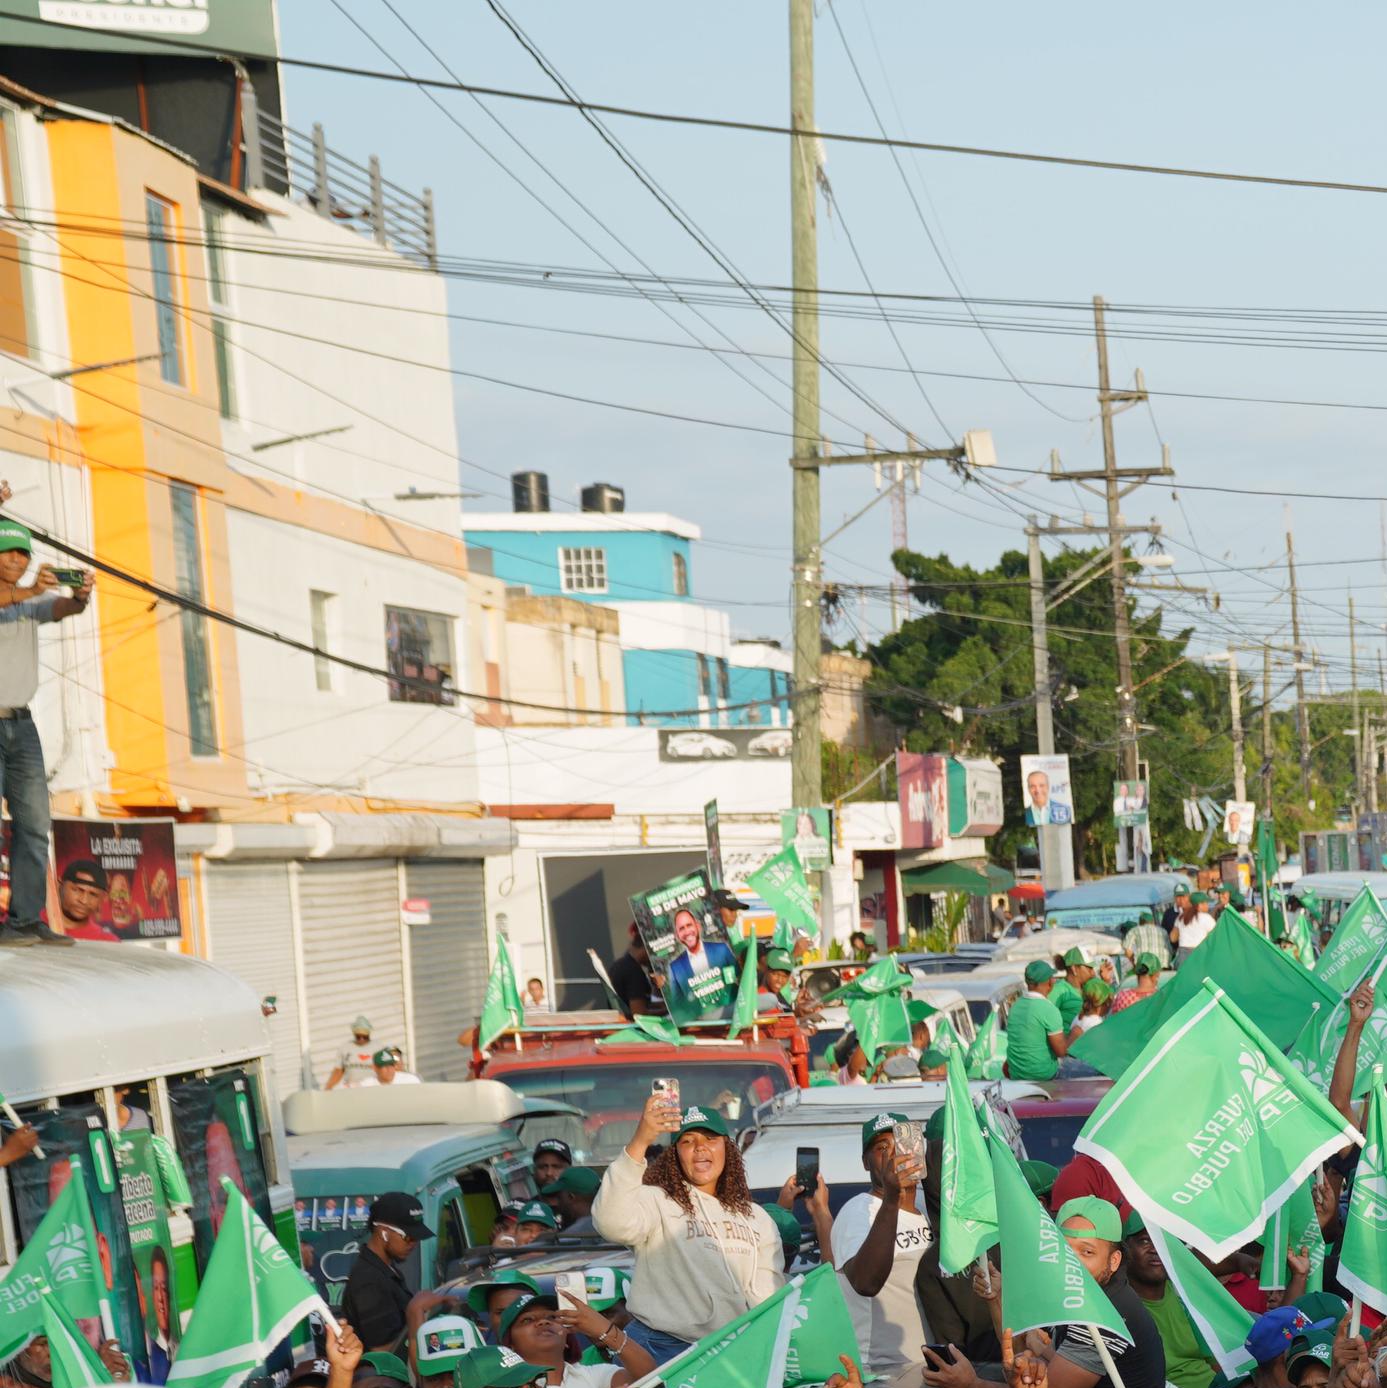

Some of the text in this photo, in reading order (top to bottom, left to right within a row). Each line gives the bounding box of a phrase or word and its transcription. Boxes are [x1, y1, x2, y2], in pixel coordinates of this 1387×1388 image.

[91, 837, 102, 855] LA
[651, 886, 706, 916] 19 DE MAYO
[687, 966, 721, 987] DILUVIO
[693, 979, 725, 999] VERDES
